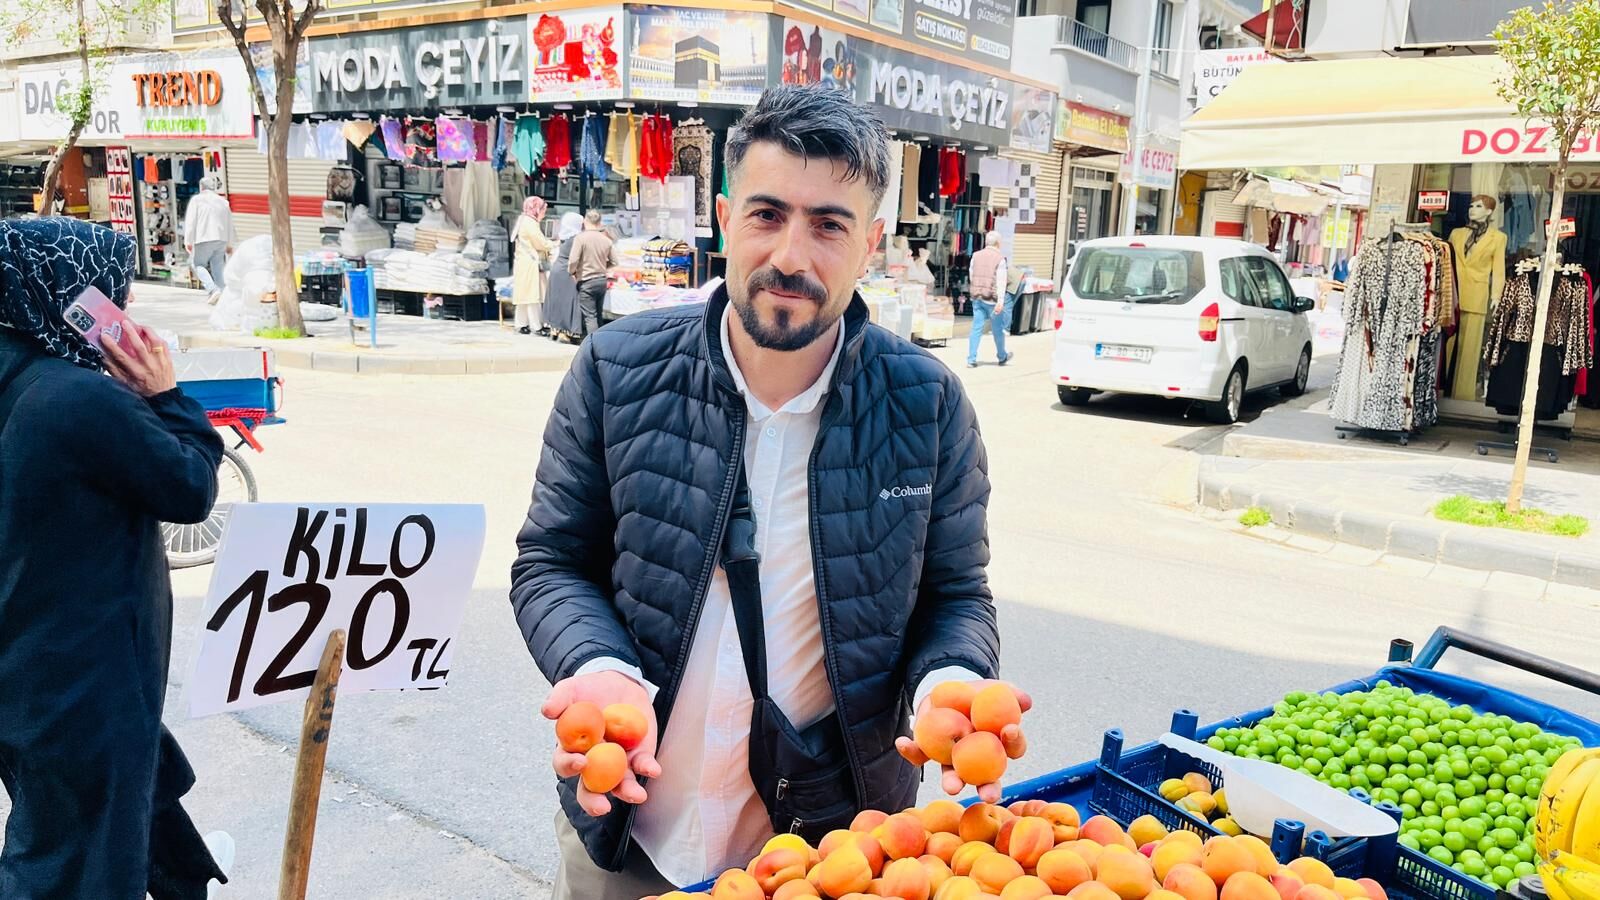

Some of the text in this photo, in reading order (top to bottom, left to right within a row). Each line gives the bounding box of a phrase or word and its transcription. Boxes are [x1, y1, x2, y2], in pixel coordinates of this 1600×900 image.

[916, 16, 966, 43] SATIŞ NOKTASI
[313, 20, 522, 99] MODA ÇEYİZ
[132, 70, 223, 107] TREND
[869, 60, 1010, 131] MODA ÇEYİZ
[1461, 127, 1551, 155] DOZ
[206, 570, 410, 703] 120
